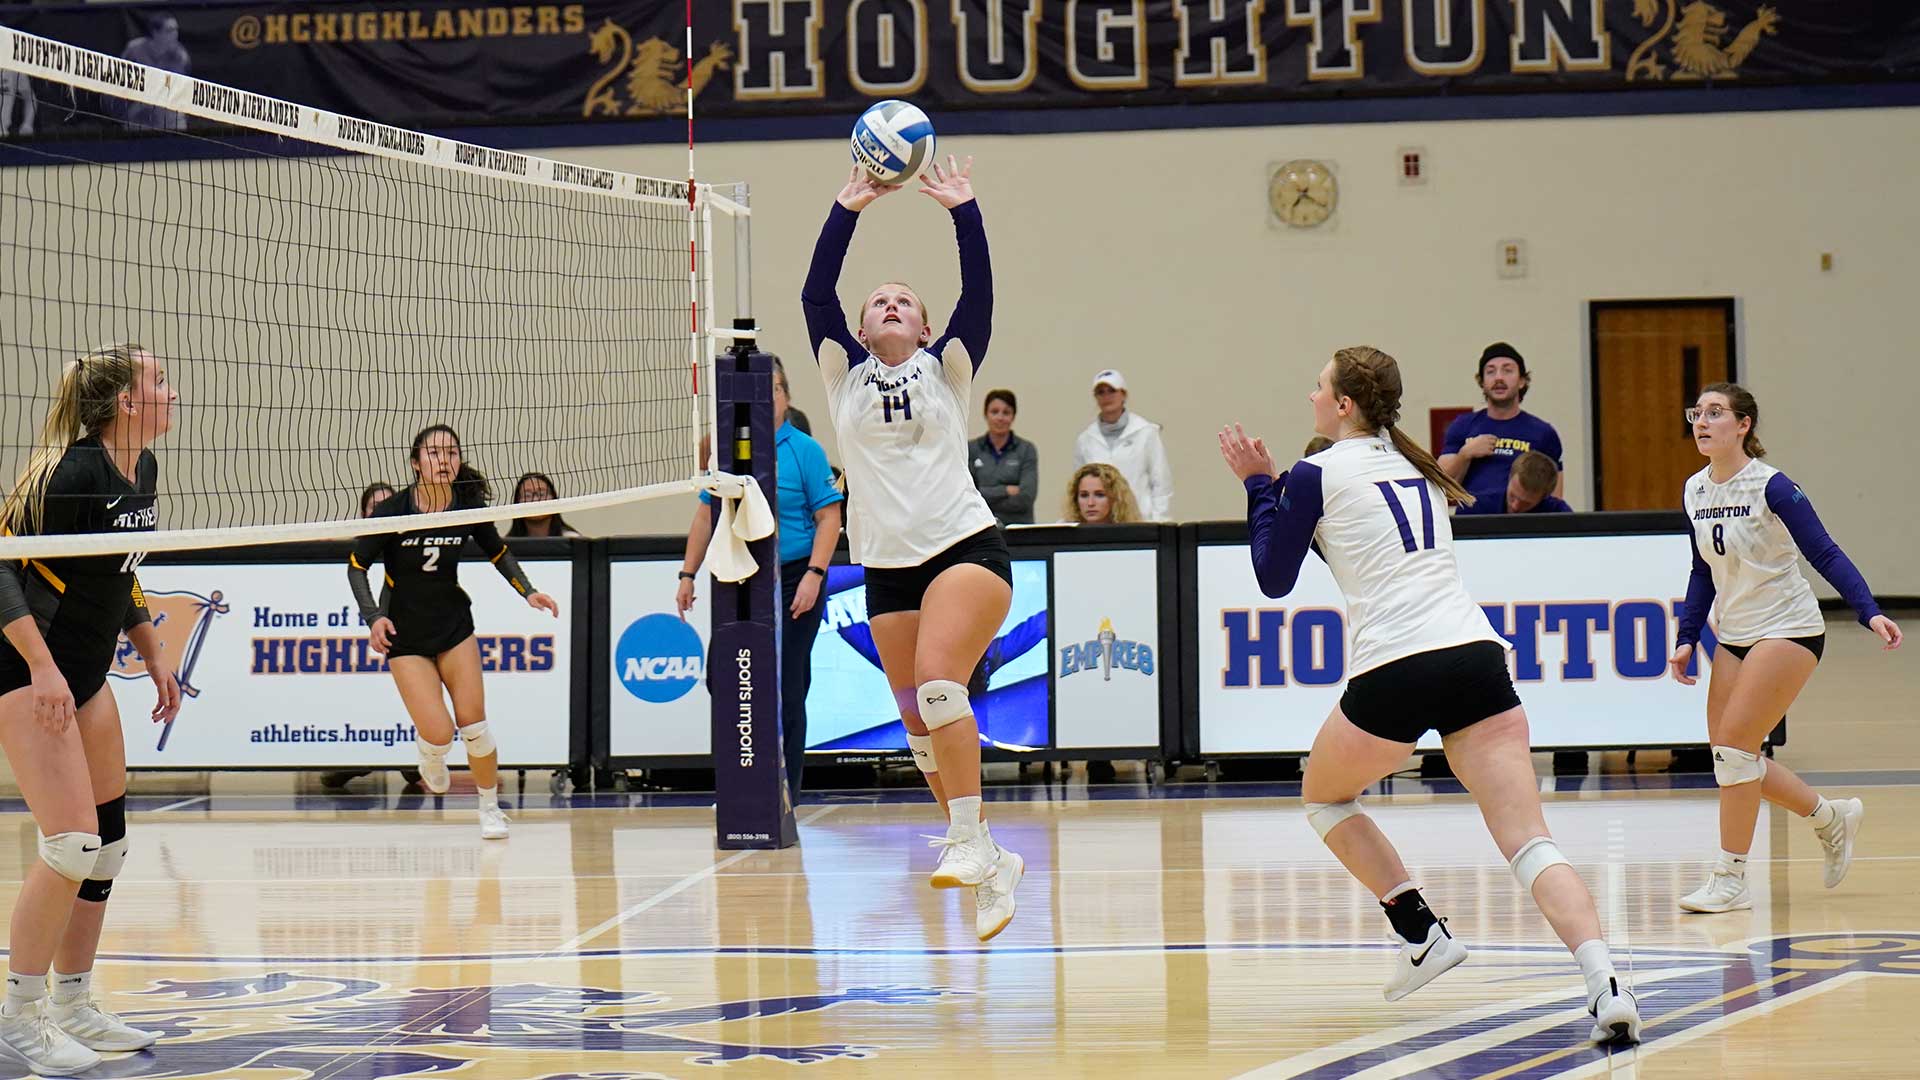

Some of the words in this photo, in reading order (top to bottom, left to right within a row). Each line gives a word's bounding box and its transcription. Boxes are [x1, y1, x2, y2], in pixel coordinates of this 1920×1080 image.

[231, 5, 586, 48] @HCHIGHLANDERS
[13, 33, 73, 73] HOUGHTON
[75, 50, 146, 92] HIGHLANDERS
[734, 0, 1611, 99] HOUGHTON
[192, 80, 241, 115] HOUGHTON
[241, 93, 300, 128] HIGHLANDERS
[852, 138, 886, 175] molten
[883, 389, 912, 423] 14
[1374, 478, 1436, 553] 17
[1694, 505, 1751, 520] HOUGHTON
[1712, 523, 1726, 556] 8
[421, 546, 441, 572] 2
[254, 606, 318, 628] Home
[328, 605, 350, 627] of
[251, 636, 556, 674] HIGHLERS
[623, 656, 707, 681] NCAA
[736, 649, 753, 701] sports
[737, 703, 754, 767] imports
